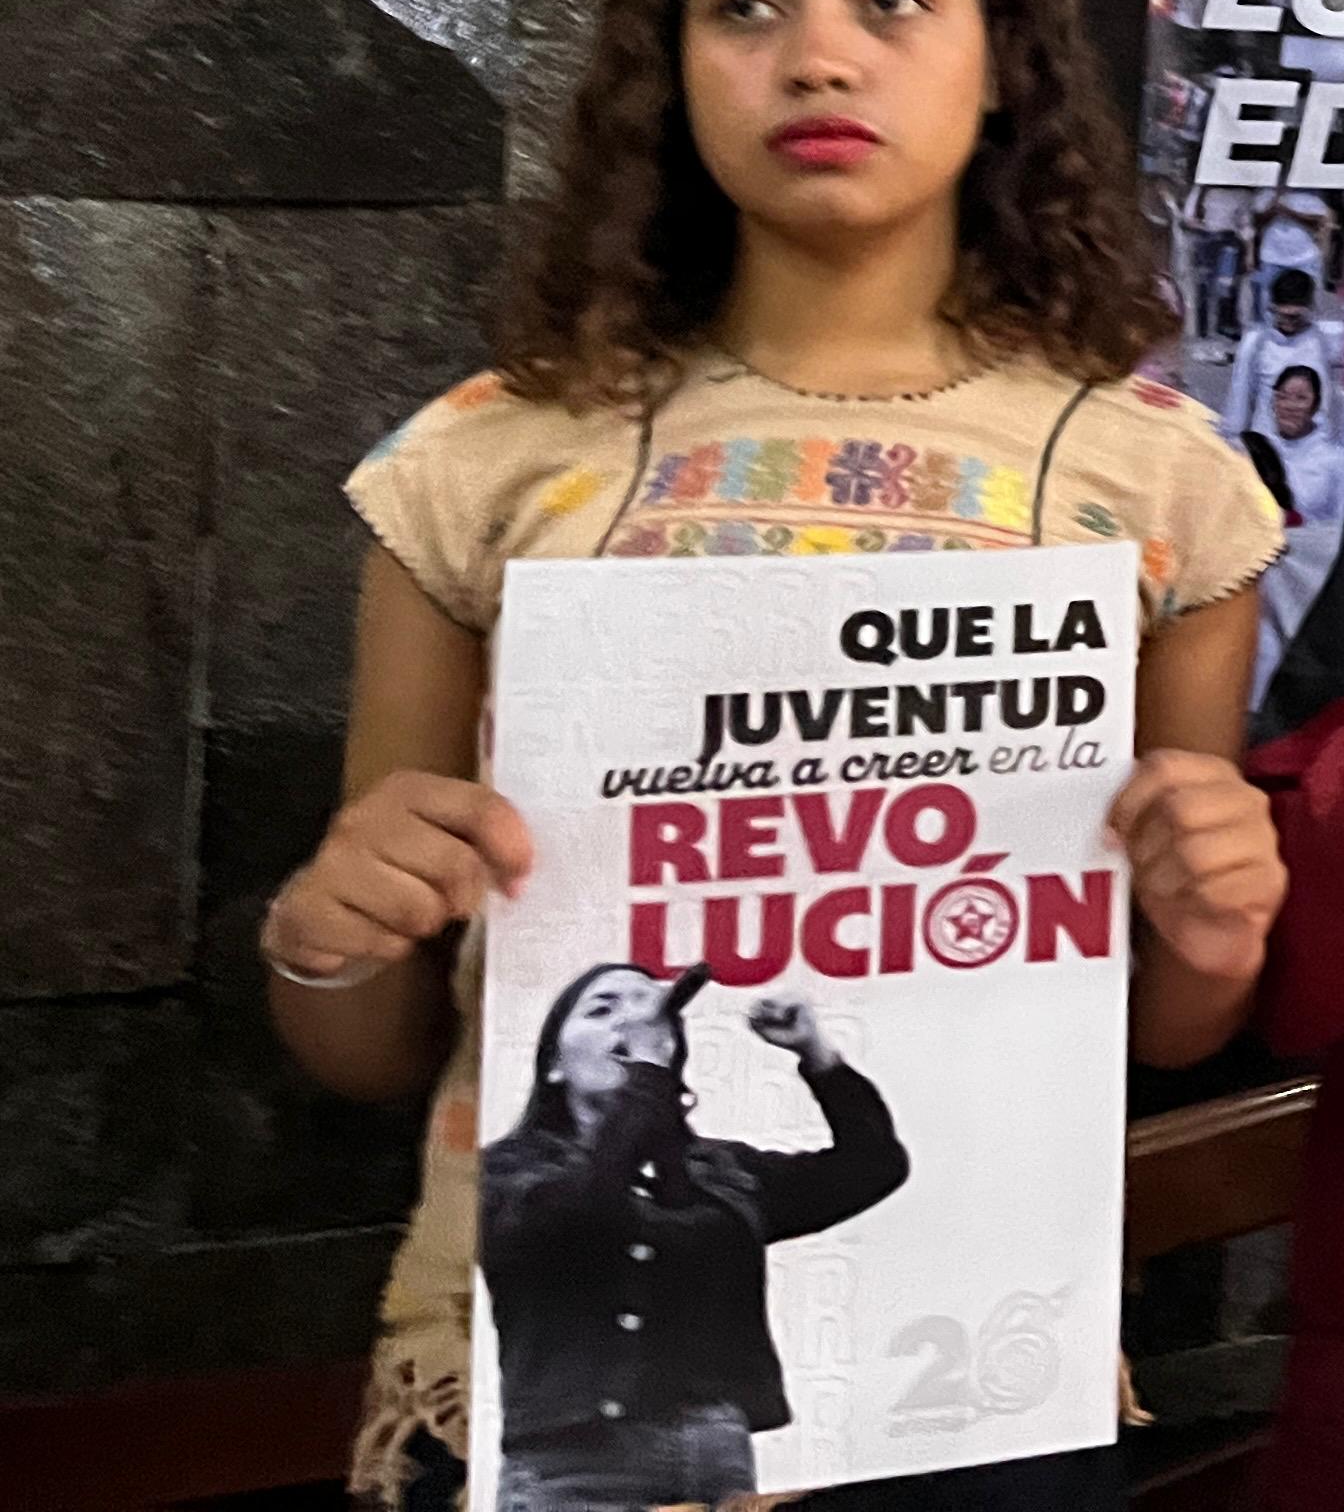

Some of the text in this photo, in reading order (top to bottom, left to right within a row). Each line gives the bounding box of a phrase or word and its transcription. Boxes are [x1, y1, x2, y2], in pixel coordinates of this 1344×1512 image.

[840, 599, 1108, 666] QUE LA
[599, 725, 1107, 800] vuelva a creer en la
[699, 674, 1107, 764] JUVENTUD
[628, 782, 978, 887] REVO
[628, 851, 1114, 988] LUCIÓN
